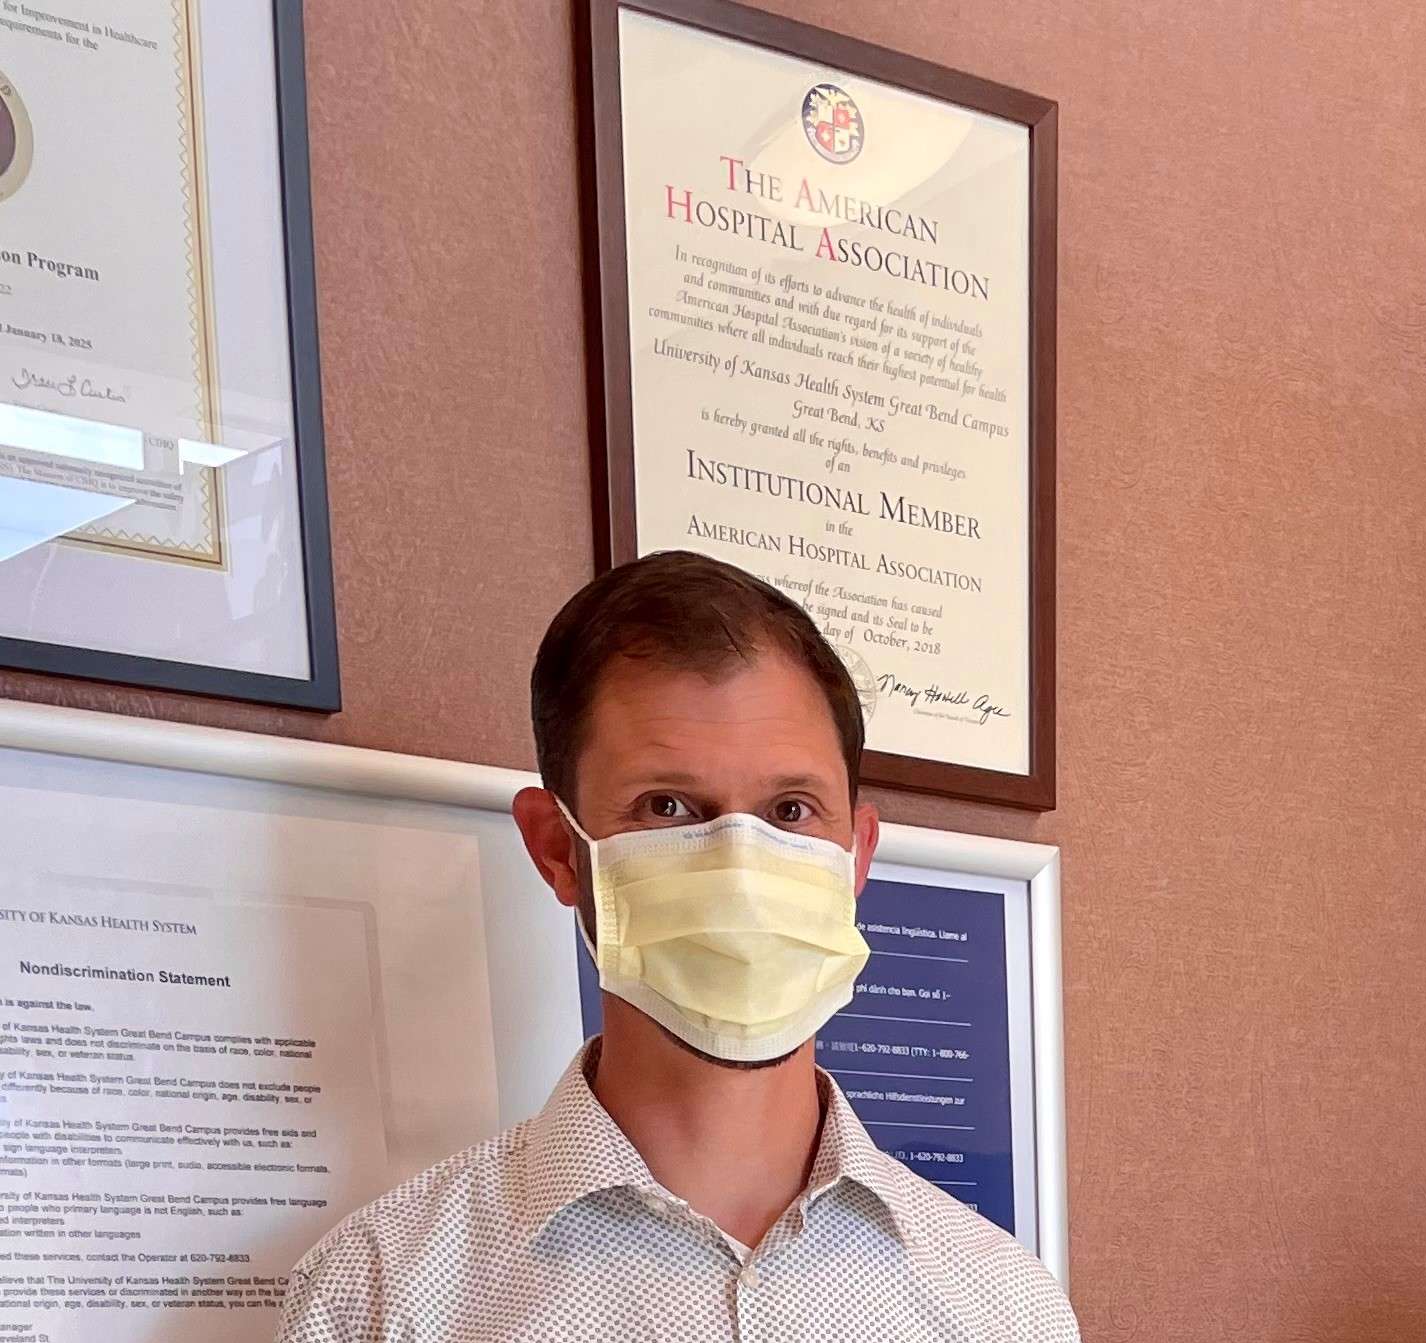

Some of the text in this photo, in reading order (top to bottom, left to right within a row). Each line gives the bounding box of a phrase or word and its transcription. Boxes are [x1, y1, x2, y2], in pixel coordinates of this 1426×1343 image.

[720, 156, 939, 244] THE AMERICAN
[27, 251, 101, 281] Program
[665, 185, 990, 300] HOSPITAL ASSOCIATION
[675, 244, 688, 263] In
[691, 252, 748, 278] recognition
[751, 267, 763, 285] of
[764, 274, 777, 286] its
[779, 274, 809, 296] efforts
[813, 285, 823, 297] to
[826, 286, 866, 309] advance
[869, 297, 885, 314] the
[887, 301, 916, 322] health
[920, 310, 931, 329] of
[683, 272, 976, 358] and communities and with due regard for its support of the
[6, 323, 48, 344] January
[649, 306, 714, 331] communities
[718, 318, 749, 341] where
[751, 329, 765, 344] all
[768, 334, 824, 359] individuals
[827, 349, 854, 366] reach
[857, 355, 880, 372] their
[882, 359, 917, 382] highest
[919, 373, 961, 393] potential
[961, 380, 977, 400] for
[676, 289, 729, 315] American
[732, 303, 779, 328] Hospital
[850, 336, 878, 354] vision
[881, 341, 892, 360] of
[903, 350, 935, 371] society
[937, 354, 947, 374] of
[949, 359, 984, 382] healthy
[653, 338, 1010, 439] University of Kansas Health System Great Bend Campus
[792, 399, 886, 433] Great Bend, KS
[701, 407, 709, 421] is
[713, 408, 748, 434] hereby
[750, 423, 790, 440] granted
[793, 428, 806, 444] all
[809, 431, 825, 447] the
[862, 443, 898, 466] benefits
[901, 455, 920, 470] and
[922, 460, 967, 482] privileges
[825, 455, 851, 474] of an
[686, 448, 981, 539] INSTITUTIONAL MEMBER
[687, 514, 982, 593] AMERICAN HOSPITAL ASSOCIATION
[825, 519, 854, 536] in the
[774, 574, 813, 598] whereof
[815, 580, 830, 597] the
[832, 586, 888, 608] Association
[891, 597, 908, 612] has
[911, 604, 943, 619] caused
[816, 604, 934, 636] signed and its Seal to be
[823, 622, 941, 655] day of October, 2018
[29, 911, 47, 923] OF
[48, 911, 98, 929] KANSAS
[101, 915, 149, 933] HEALTH
[152, 919, 197, 936] SYSTEM
[19, 960, 232, 988] Nondiscrimination Statement
